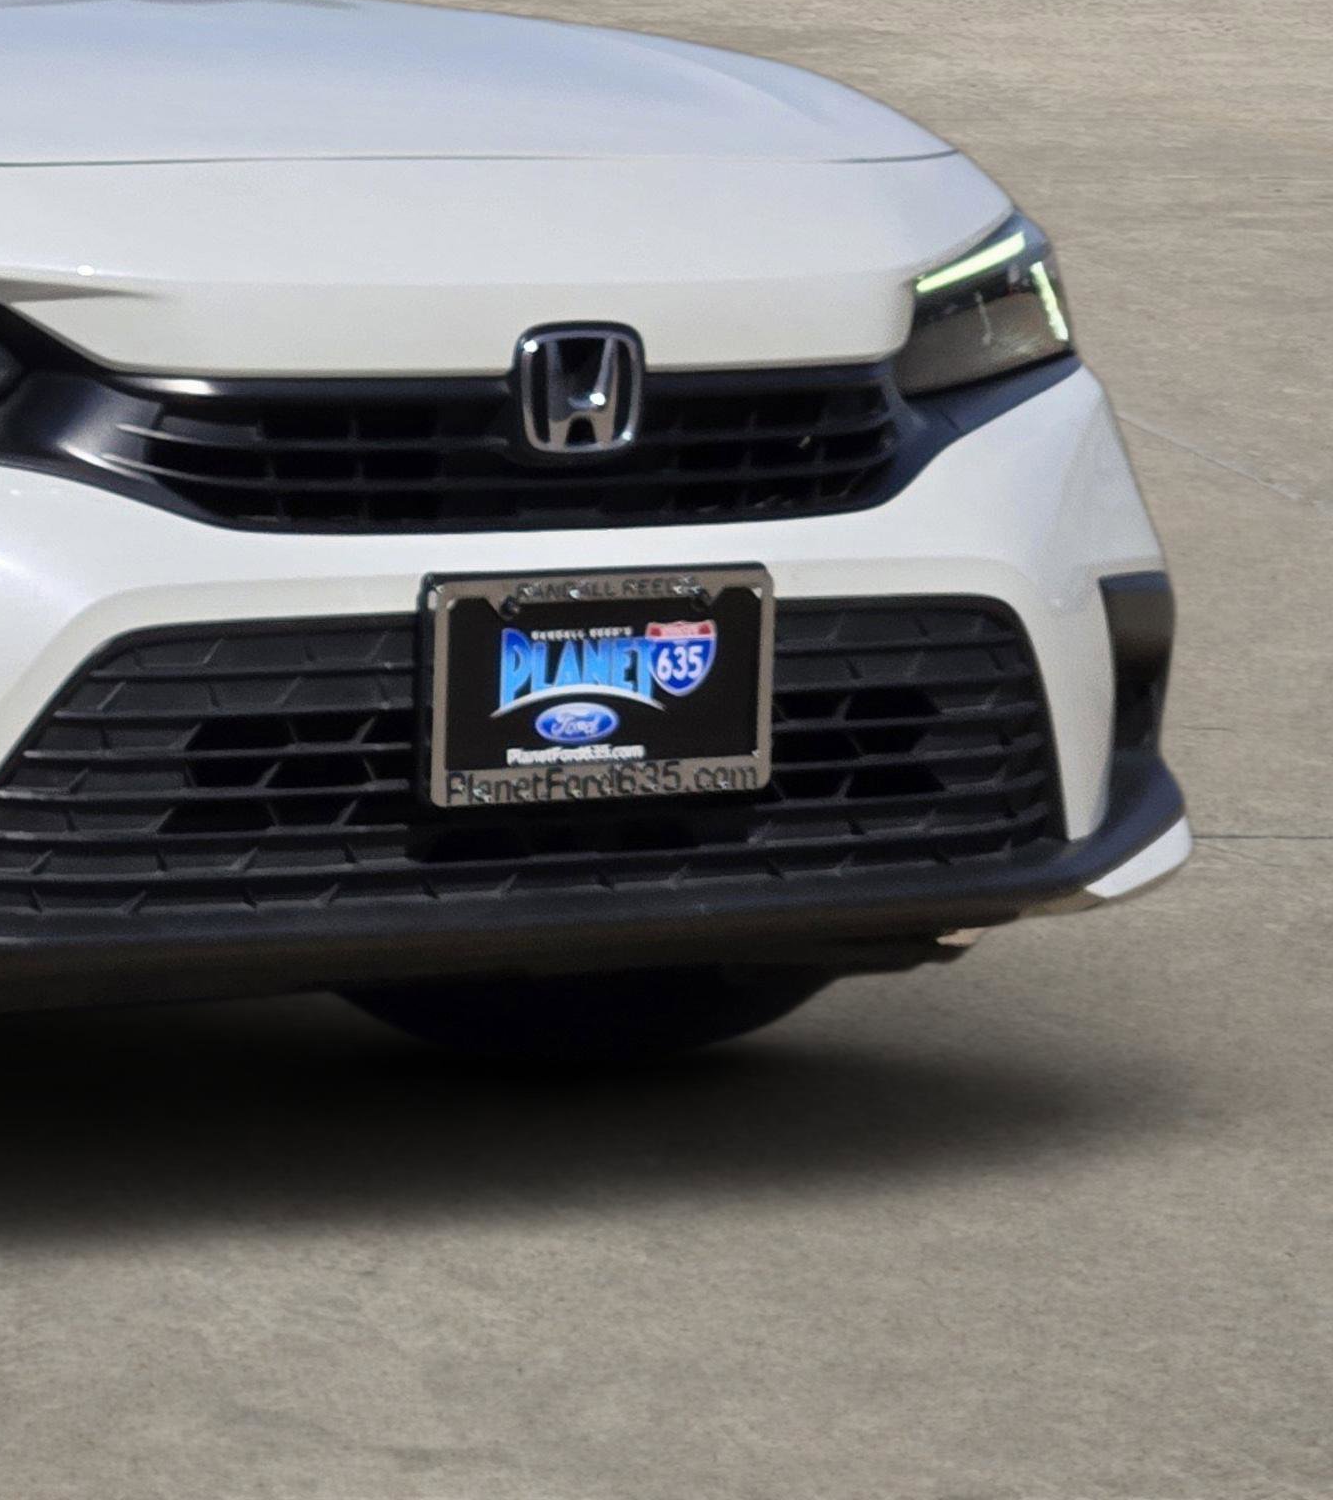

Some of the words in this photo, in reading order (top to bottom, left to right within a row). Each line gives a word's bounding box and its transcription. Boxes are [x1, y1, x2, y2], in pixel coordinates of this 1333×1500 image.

[500, 628, 653, 710] PLANET
[657, 645, 703, 681] 635
[549, 710, 600, 737] Ford
[445, 760, 758, 803] PlanetFord635.com
